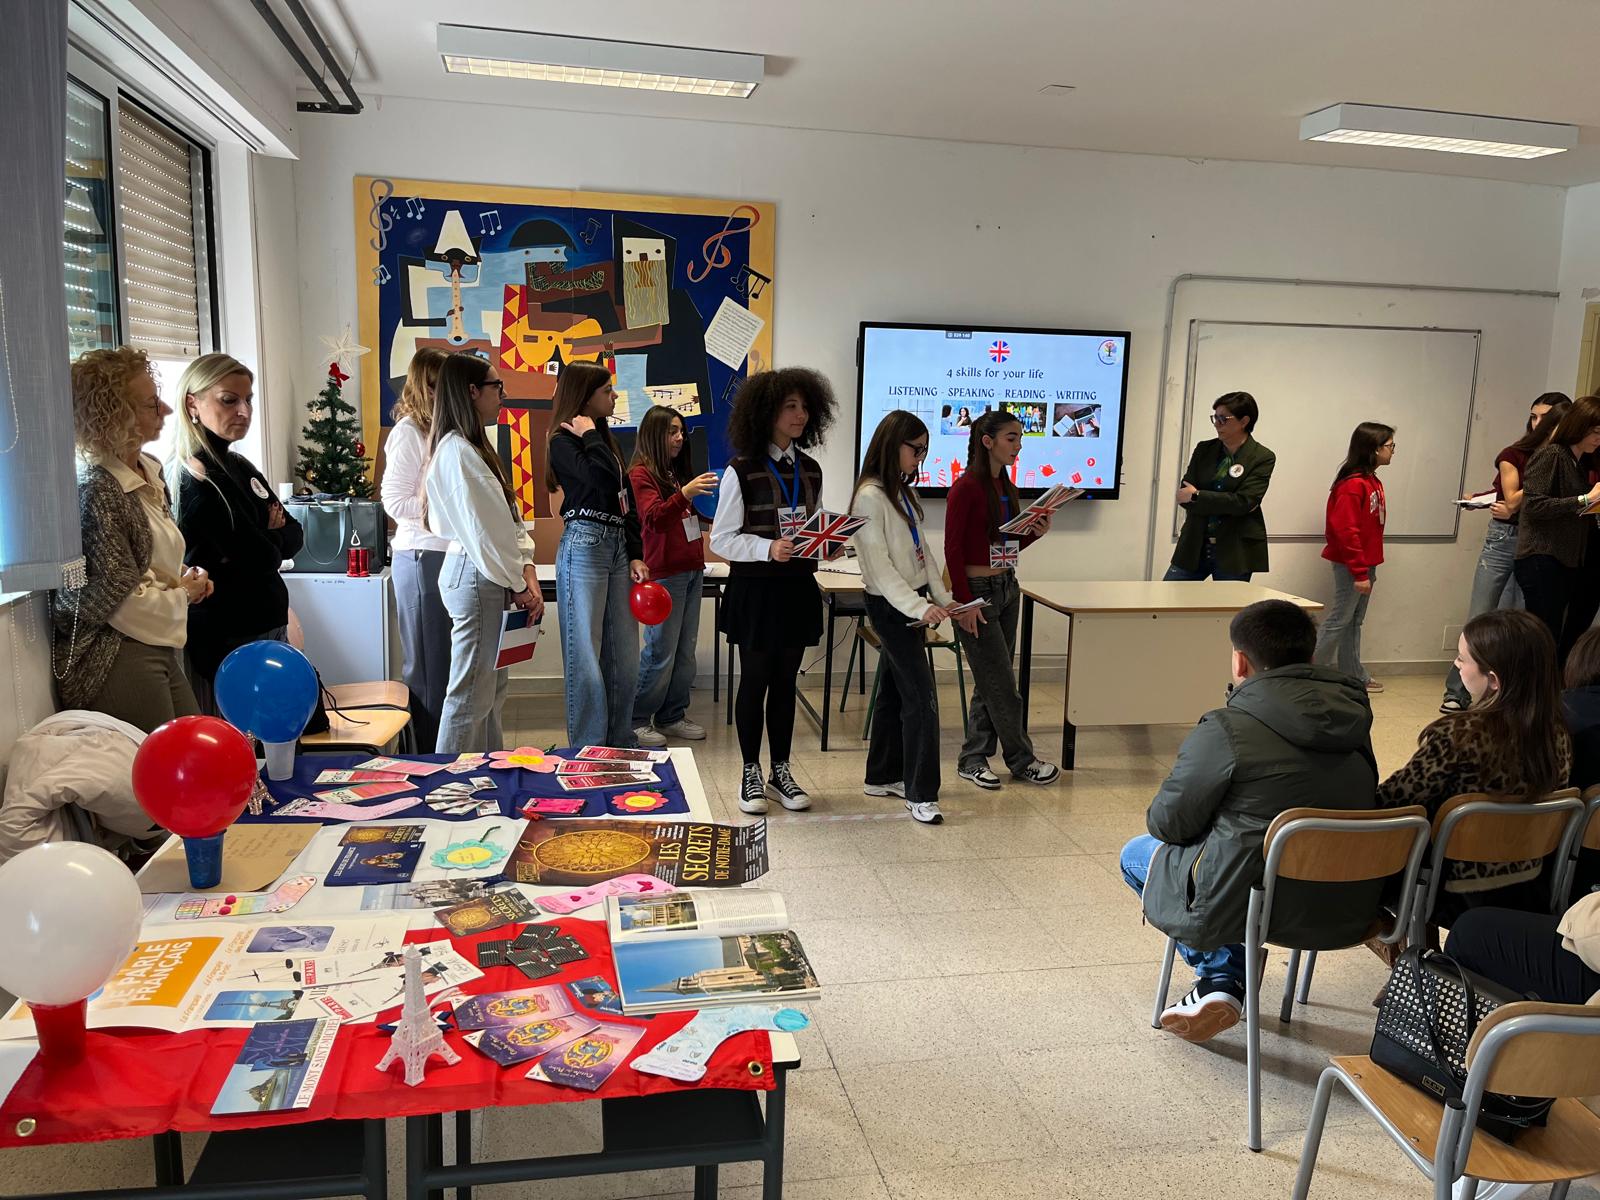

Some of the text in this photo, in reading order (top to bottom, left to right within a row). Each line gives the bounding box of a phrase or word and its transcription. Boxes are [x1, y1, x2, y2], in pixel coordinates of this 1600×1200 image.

[946, 367, 1044, 381] 4 skills for your life
[888, 386, 938, 397] LISTENING
[947, 387, 995, 398] SPEAKING
[1005, 389, 1046, 399] READING
[1056, 390, 1097, 400] WRITING
[579, 508, 609, 521] NIKE
[659, 842, 682, 860] LES
[682, 825, 713, 881] SECRETS
[714, 827, 732, 880] DE NOTRE-DAME
[117, 943, 170, 986] PARLE
[132, 941, 193, 1001] FRANÇAIS
[303, 1069, 320, 1093] MONT
[297, 1094, 310, 1105] LE
